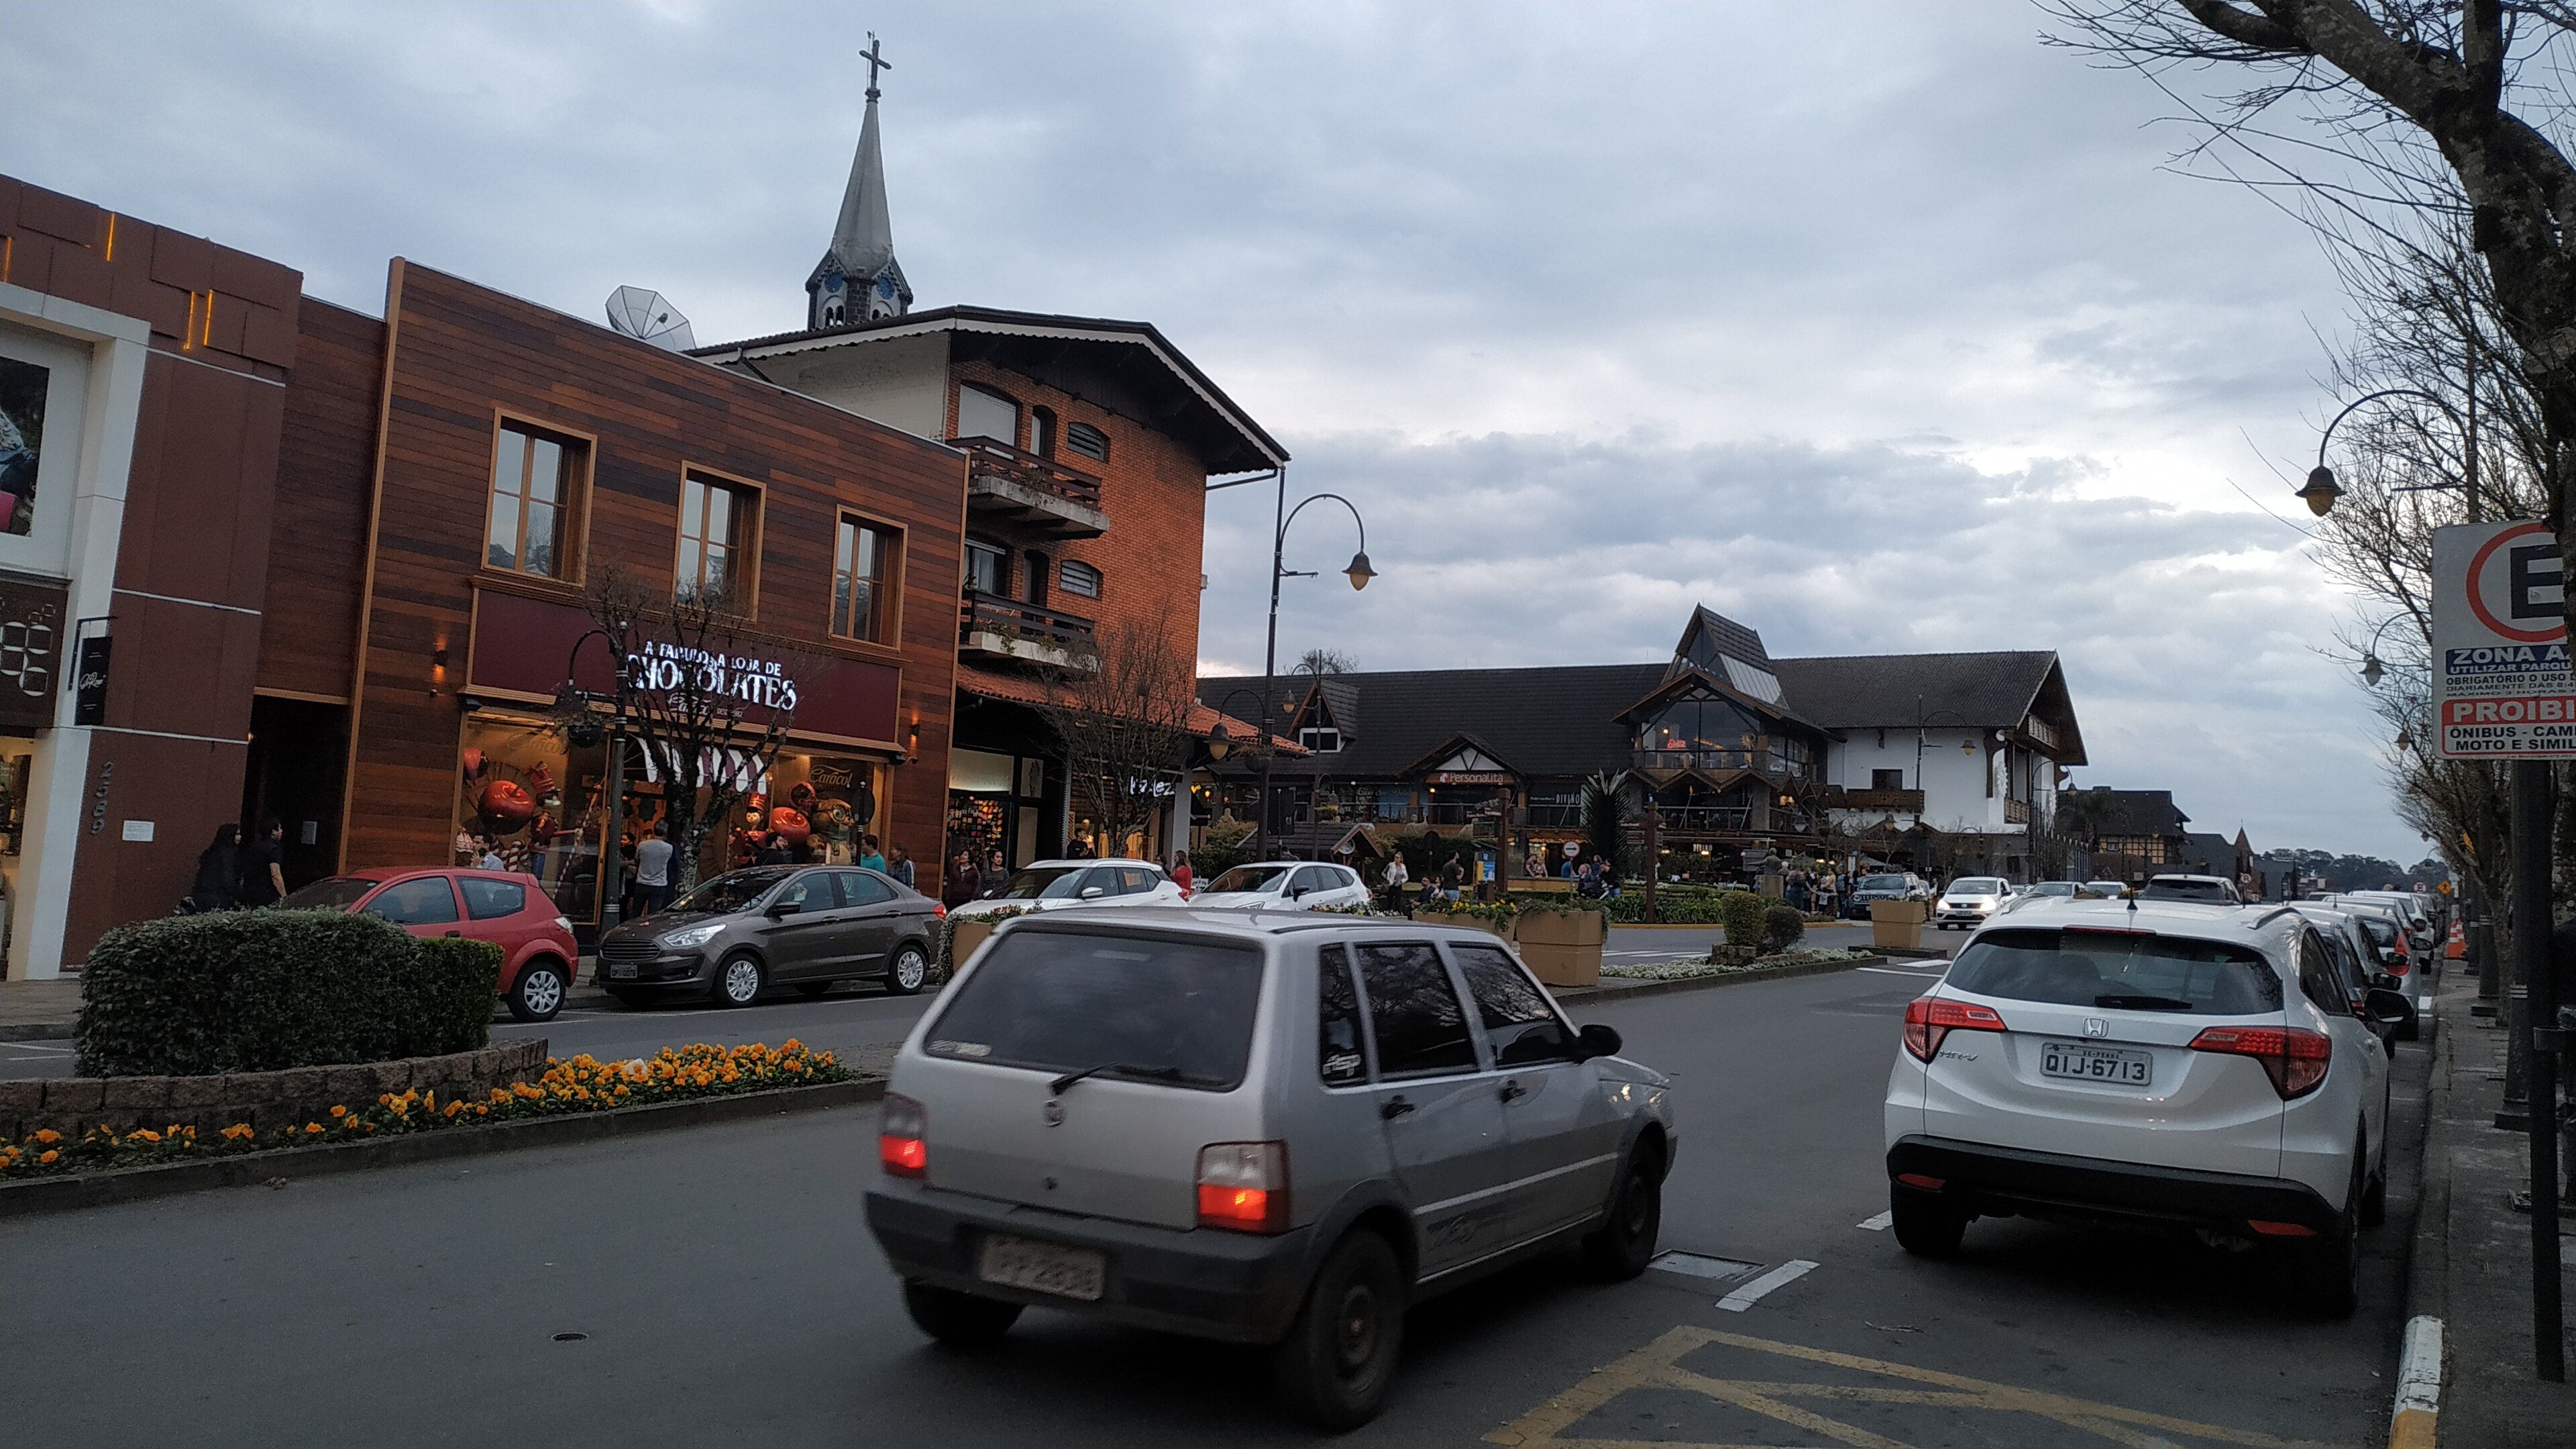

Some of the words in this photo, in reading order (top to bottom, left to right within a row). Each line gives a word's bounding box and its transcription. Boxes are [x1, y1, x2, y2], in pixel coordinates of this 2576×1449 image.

[2510, 544, 2565, 619] E
[2453, 647, 2536, 665] ZONA
[765, 661, 782, 677] DE
[2450, 663, 2516, 674] UTILIZAR
[2521, 661, 2572, 671] PARQU
[628, 654, 797, 711] CHOOLATES
[2529, 674, 2537, 682] O
[2541, 673, 2566, 682] USO
[2446, 683, 2525, 692] DIARIAMENTE
[2453, 700, 2576, 722] PROIBI
[2450, 726, 2516, 739] ÔNIBUS
[2532, 726, 2576, 737] CAM
[2455, 739, 2506, 751] MOTO
[2512, 739, 2522, 750] E
[2528, 739, 2576, 749] SIMIL
[809, 764, 853, 786] Caracol
[1556, 793, 1580, 804] DIVINO
